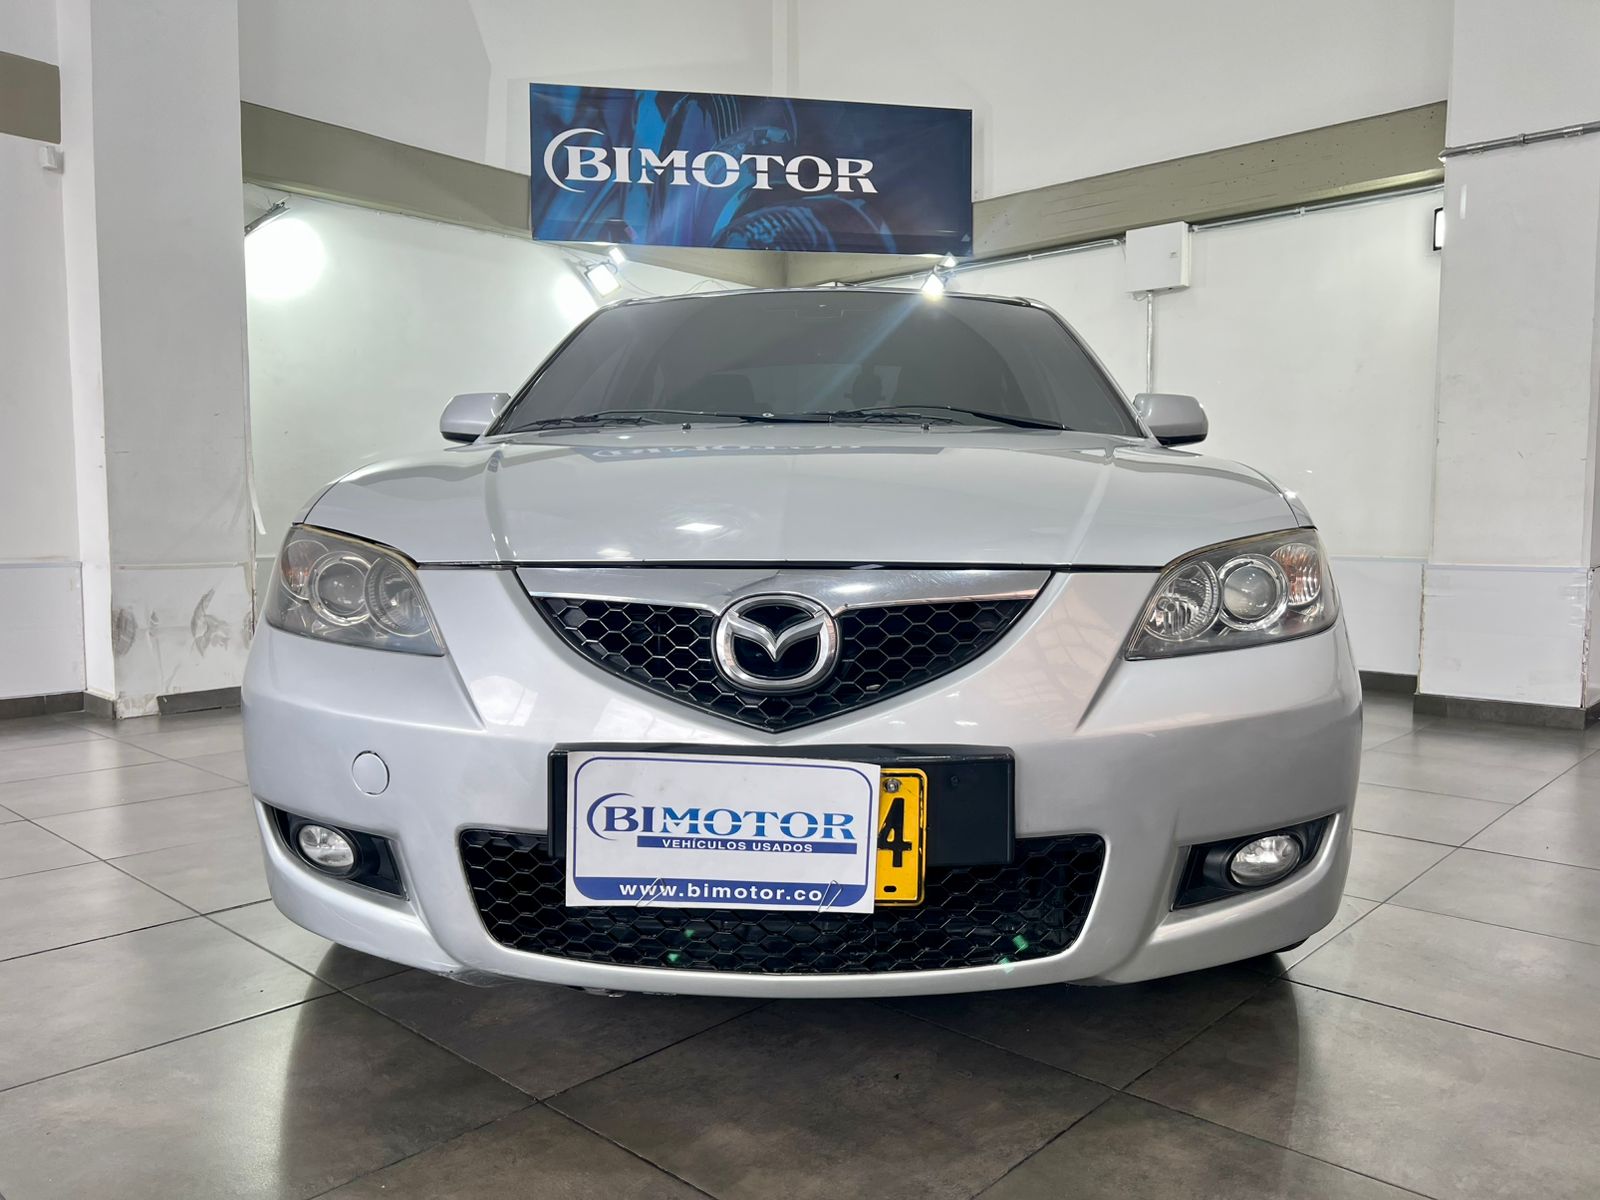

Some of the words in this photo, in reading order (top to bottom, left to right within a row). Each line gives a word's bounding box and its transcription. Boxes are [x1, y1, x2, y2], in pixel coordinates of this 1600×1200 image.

[563, 146, 878, 194] BIMOTOR
[603, 806, 855, 840] BIMOTOR
[877, 797, 912, 868] 4
[662, 838, 747, 851] VEHÍCULOS
[752, 842, 813, 853] USADOS
[619, 882, 823, 901] www.bimotor.co
